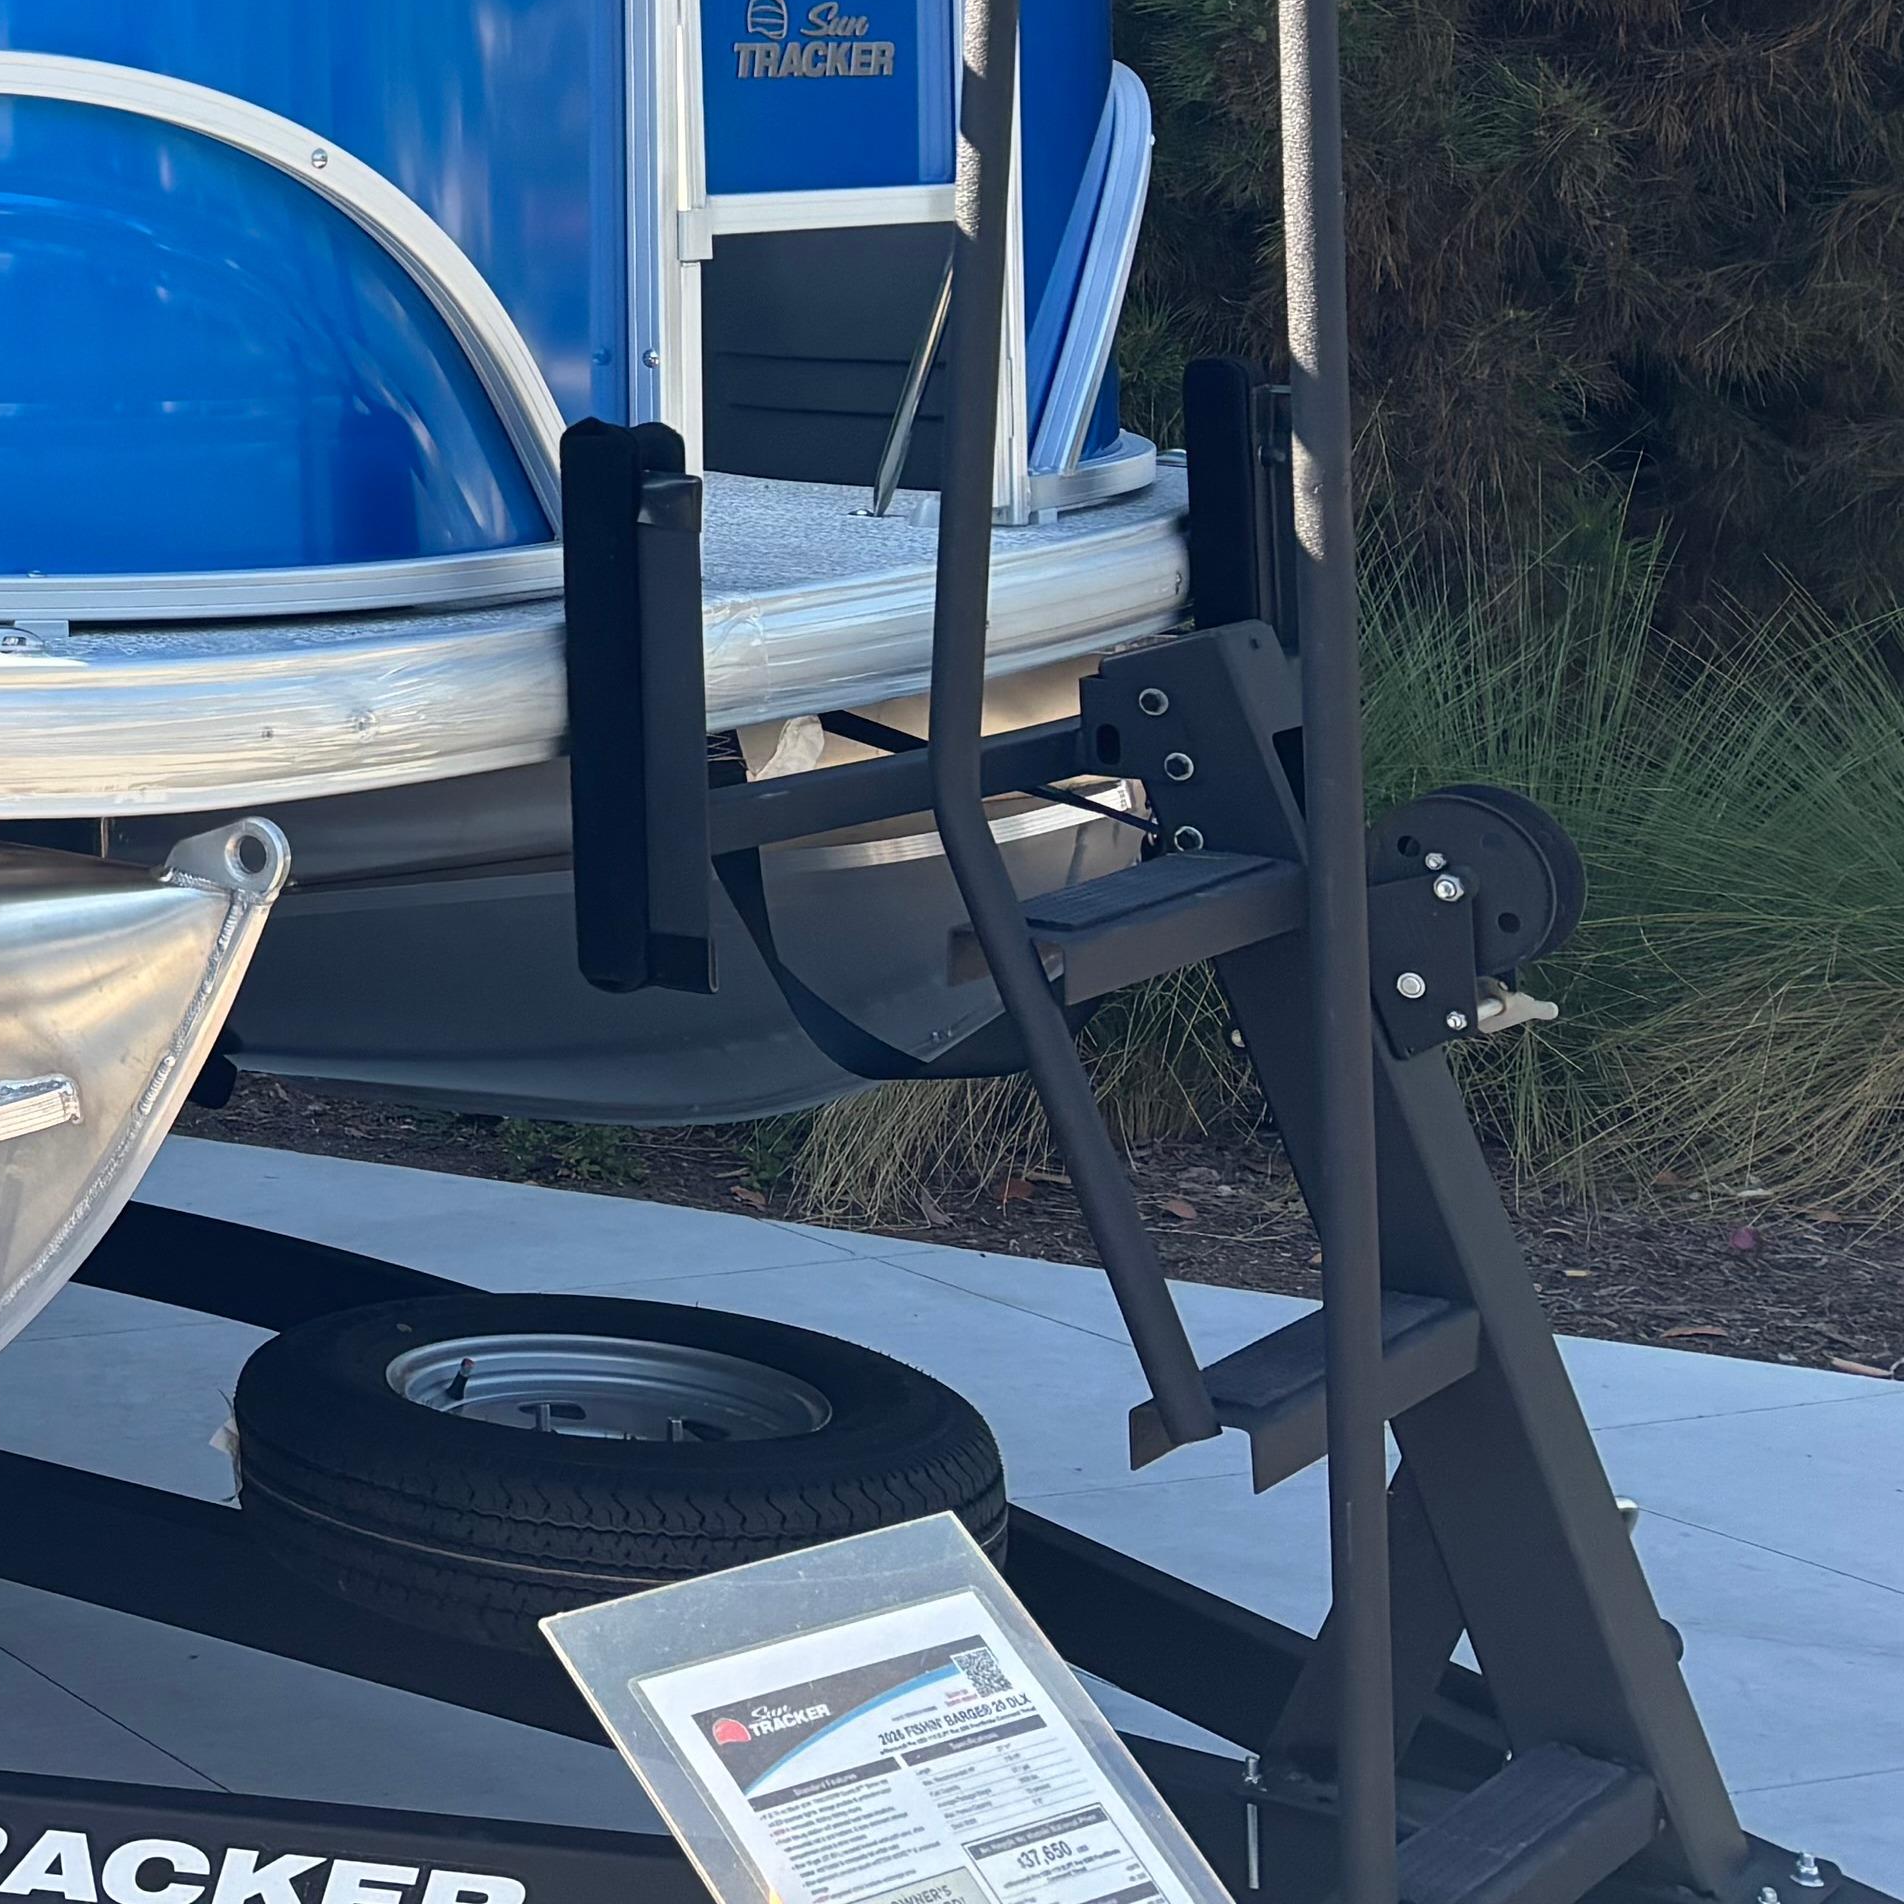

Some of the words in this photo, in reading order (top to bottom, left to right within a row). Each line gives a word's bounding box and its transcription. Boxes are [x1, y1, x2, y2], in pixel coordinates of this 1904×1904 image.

[800, 1, 869, 38] Sun
[733, 41, 895, 79] TRACKER
[751, 1704, 792, 1723] Sun
[1005, 1693, 1032, 1709] DLX
[748, 1703, 832, 1737] TRACKER
[1017, 1840, 1073, 1871] $37,650
